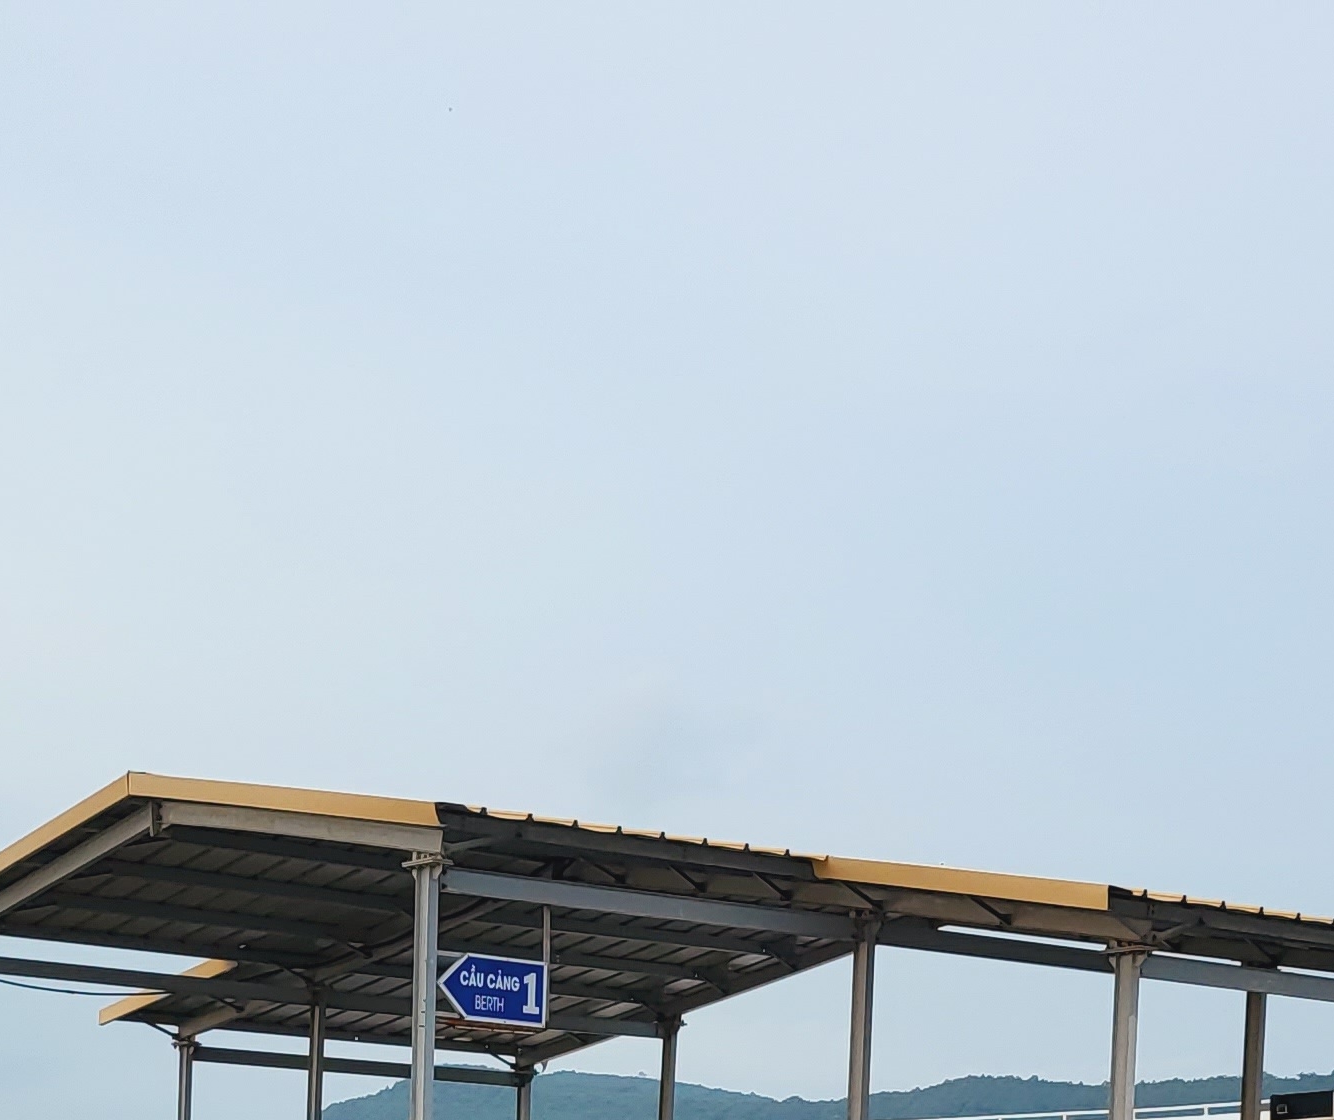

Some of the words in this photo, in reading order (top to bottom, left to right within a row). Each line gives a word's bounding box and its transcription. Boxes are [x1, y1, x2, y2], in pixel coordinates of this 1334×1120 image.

[460, 964, 484, 988] CẦU
[487, 969, 521, 992] CẢNG
[474, 994, 505, 1013] BERTH
[522, 972, 540, 1015] 1
